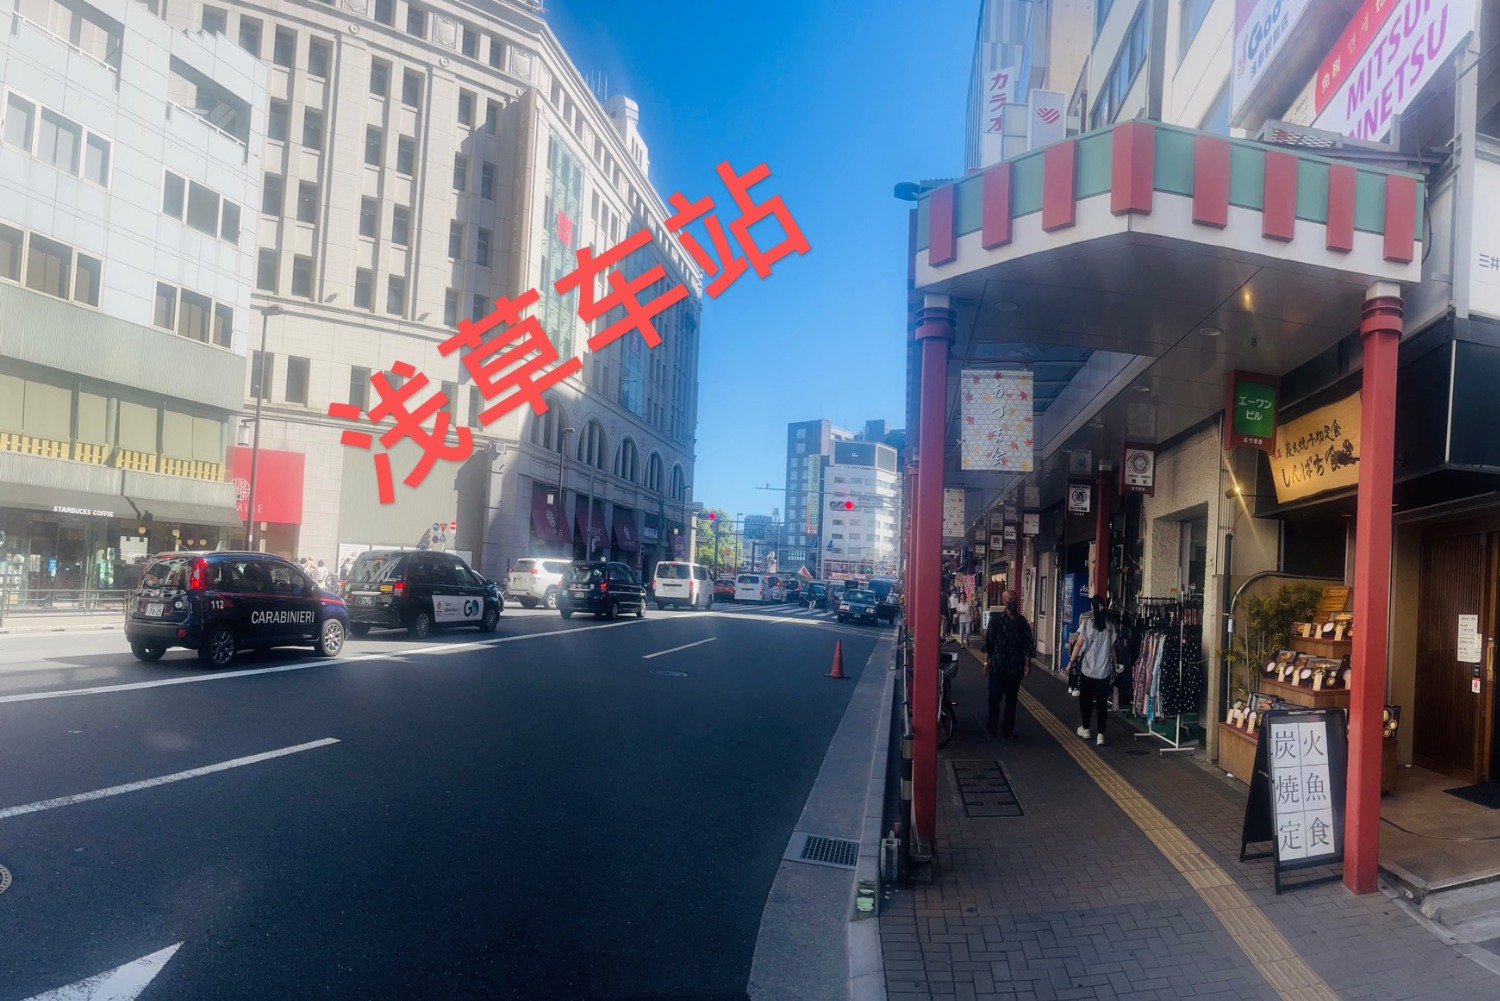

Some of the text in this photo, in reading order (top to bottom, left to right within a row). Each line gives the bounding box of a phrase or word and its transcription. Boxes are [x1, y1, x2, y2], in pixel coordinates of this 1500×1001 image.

[1238, 396, 1272, 409] エーワン
[1245, 409, 1263, 421] ビル
[53, 505, 114, 518] STARBUCKS COFFEE
[234, 503, 264, 514] MIE
[211, 600, 225, 610] 112
[251, 610, 315, 625] CARABINIERI
[1275, 730, 1325, 760] 炭火
[1276, 772, 1327, 805] 焼魚
[1280, 817, 1330, 851] 定食
